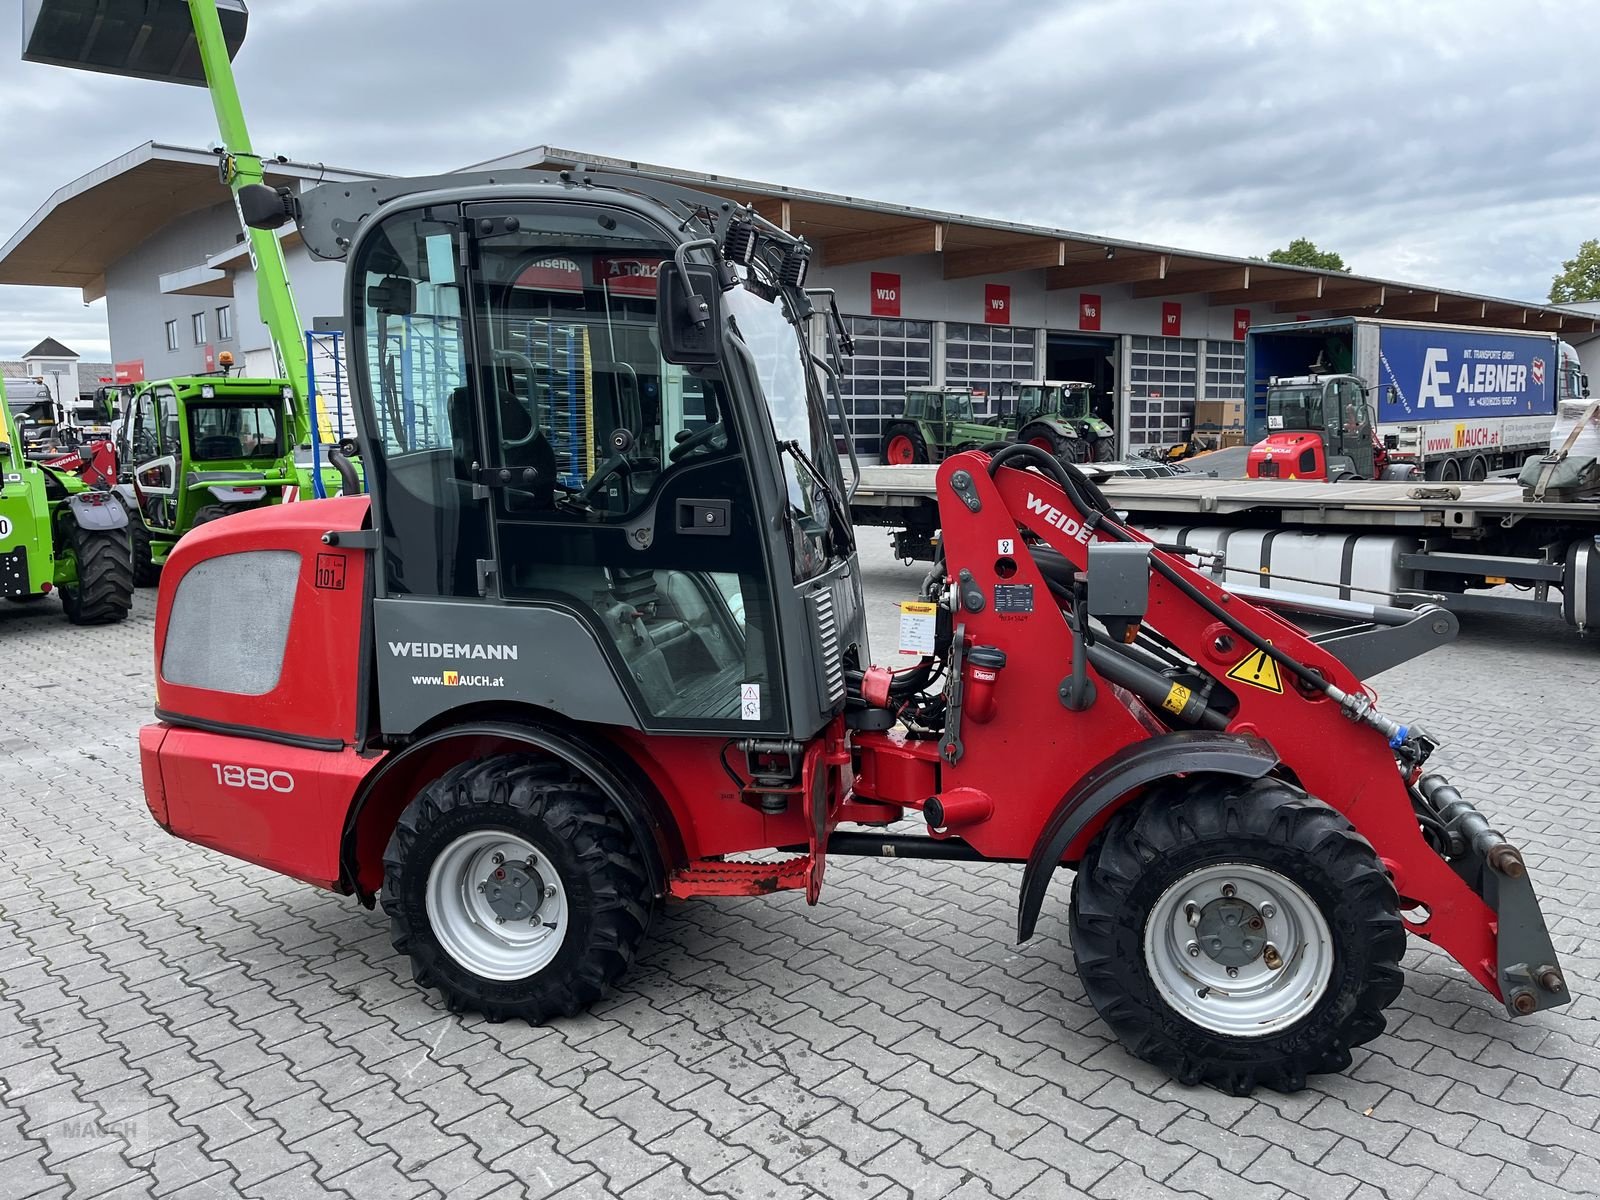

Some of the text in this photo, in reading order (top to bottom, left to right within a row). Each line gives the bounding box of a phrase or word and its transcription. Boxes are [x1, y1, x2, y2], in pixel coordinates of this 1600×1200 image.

[877, 289, 896, 301] W10
[991, 299, 1004, 310] W9
[1085, 308, 1096, 318] W8
[1167, 314, 1177, 324] W7
[1456, 363, 1527, 393] A.EBNER
[319, 568, 335, 587] 101
[388, 641, 518, 660] WEIDEMANN
[211, 763, 295, 793] 1880
